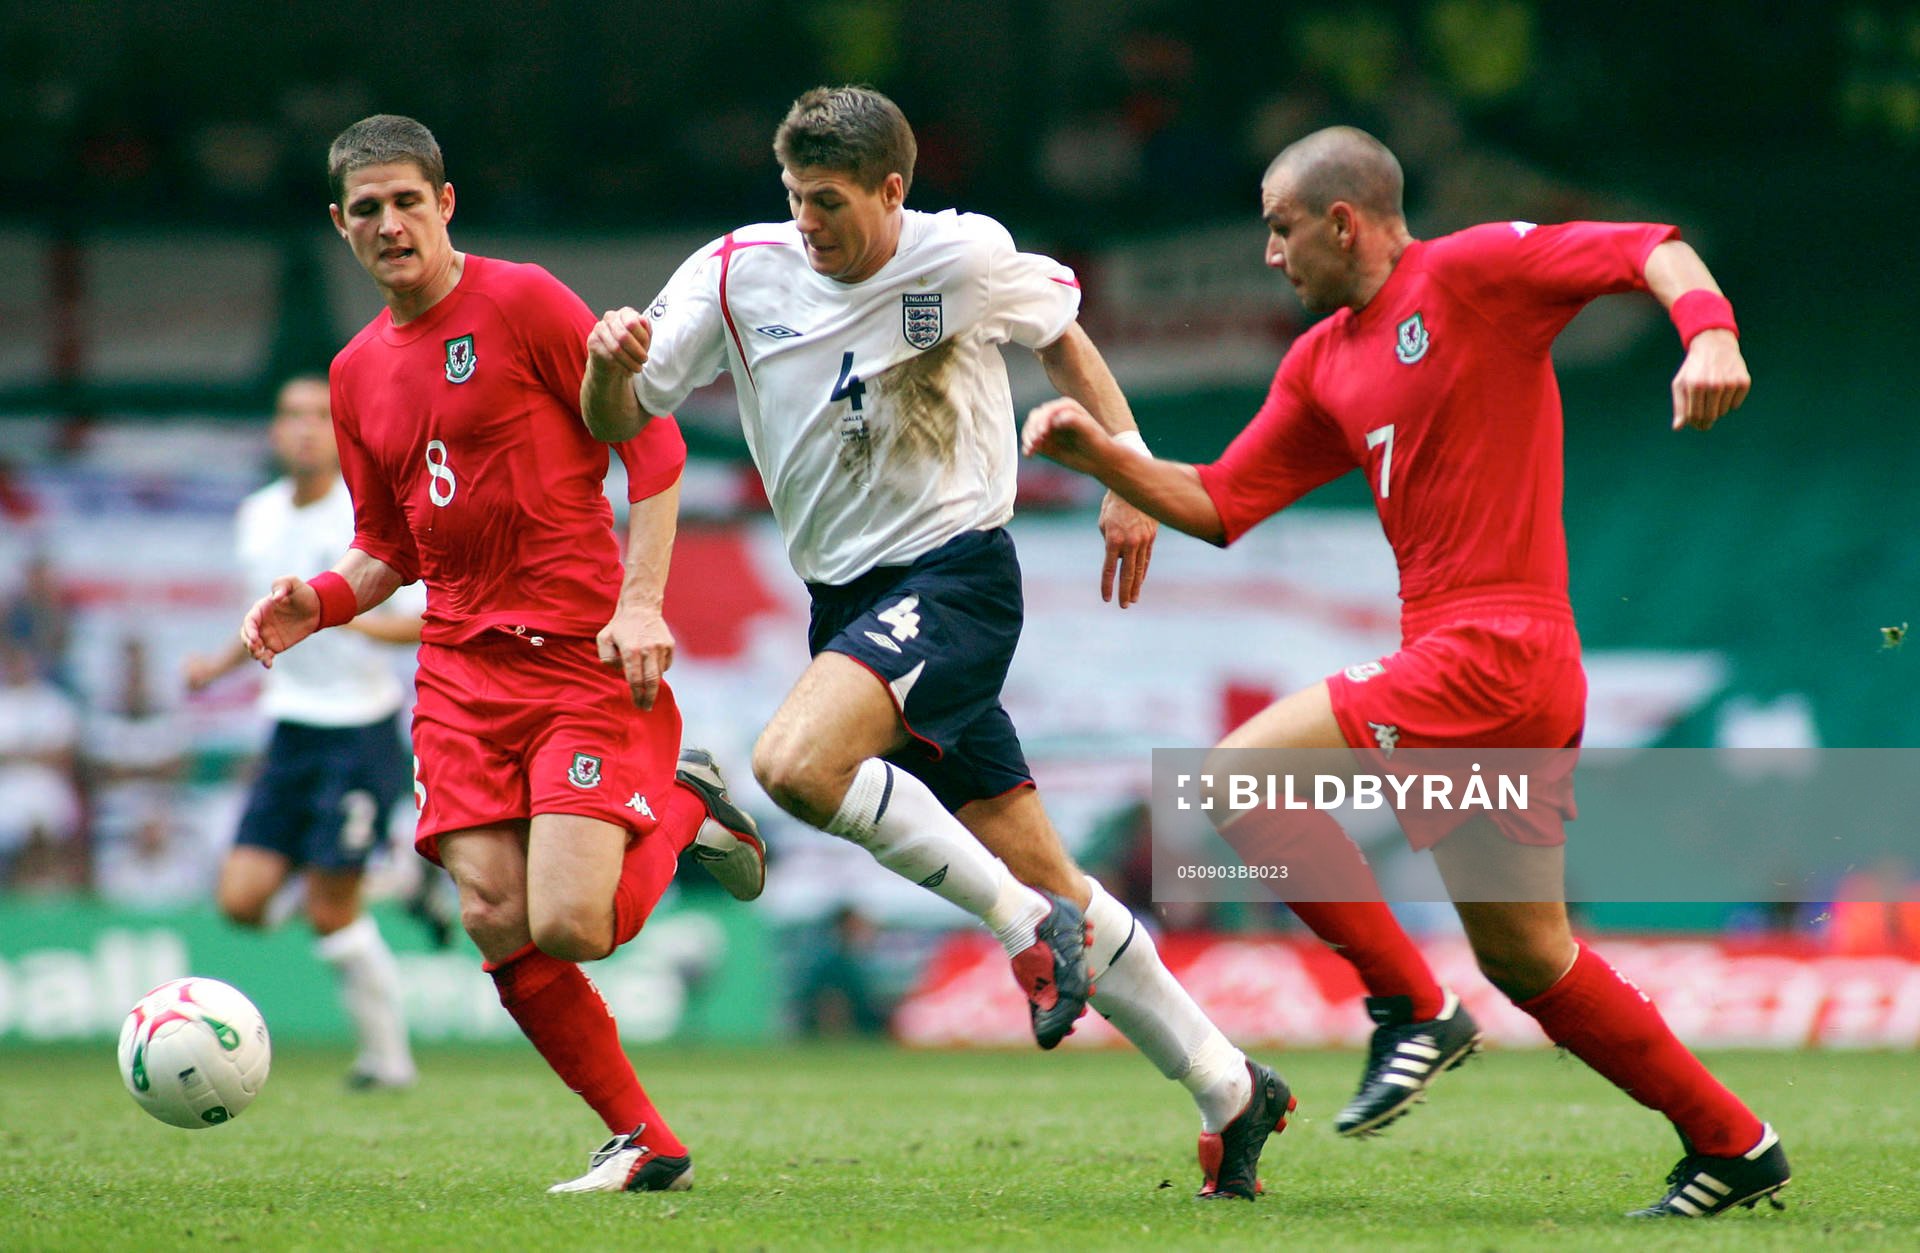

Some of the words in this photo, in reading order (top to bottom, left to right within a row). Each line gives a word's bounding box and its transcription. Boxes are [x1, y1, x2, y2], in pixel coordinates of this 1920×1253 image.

[830, 352, 866, 411] 4
[426, 440, 456, 508] 8
[1366, 424, 1395, 499] 7
[877, 593, 921, 642] 4
